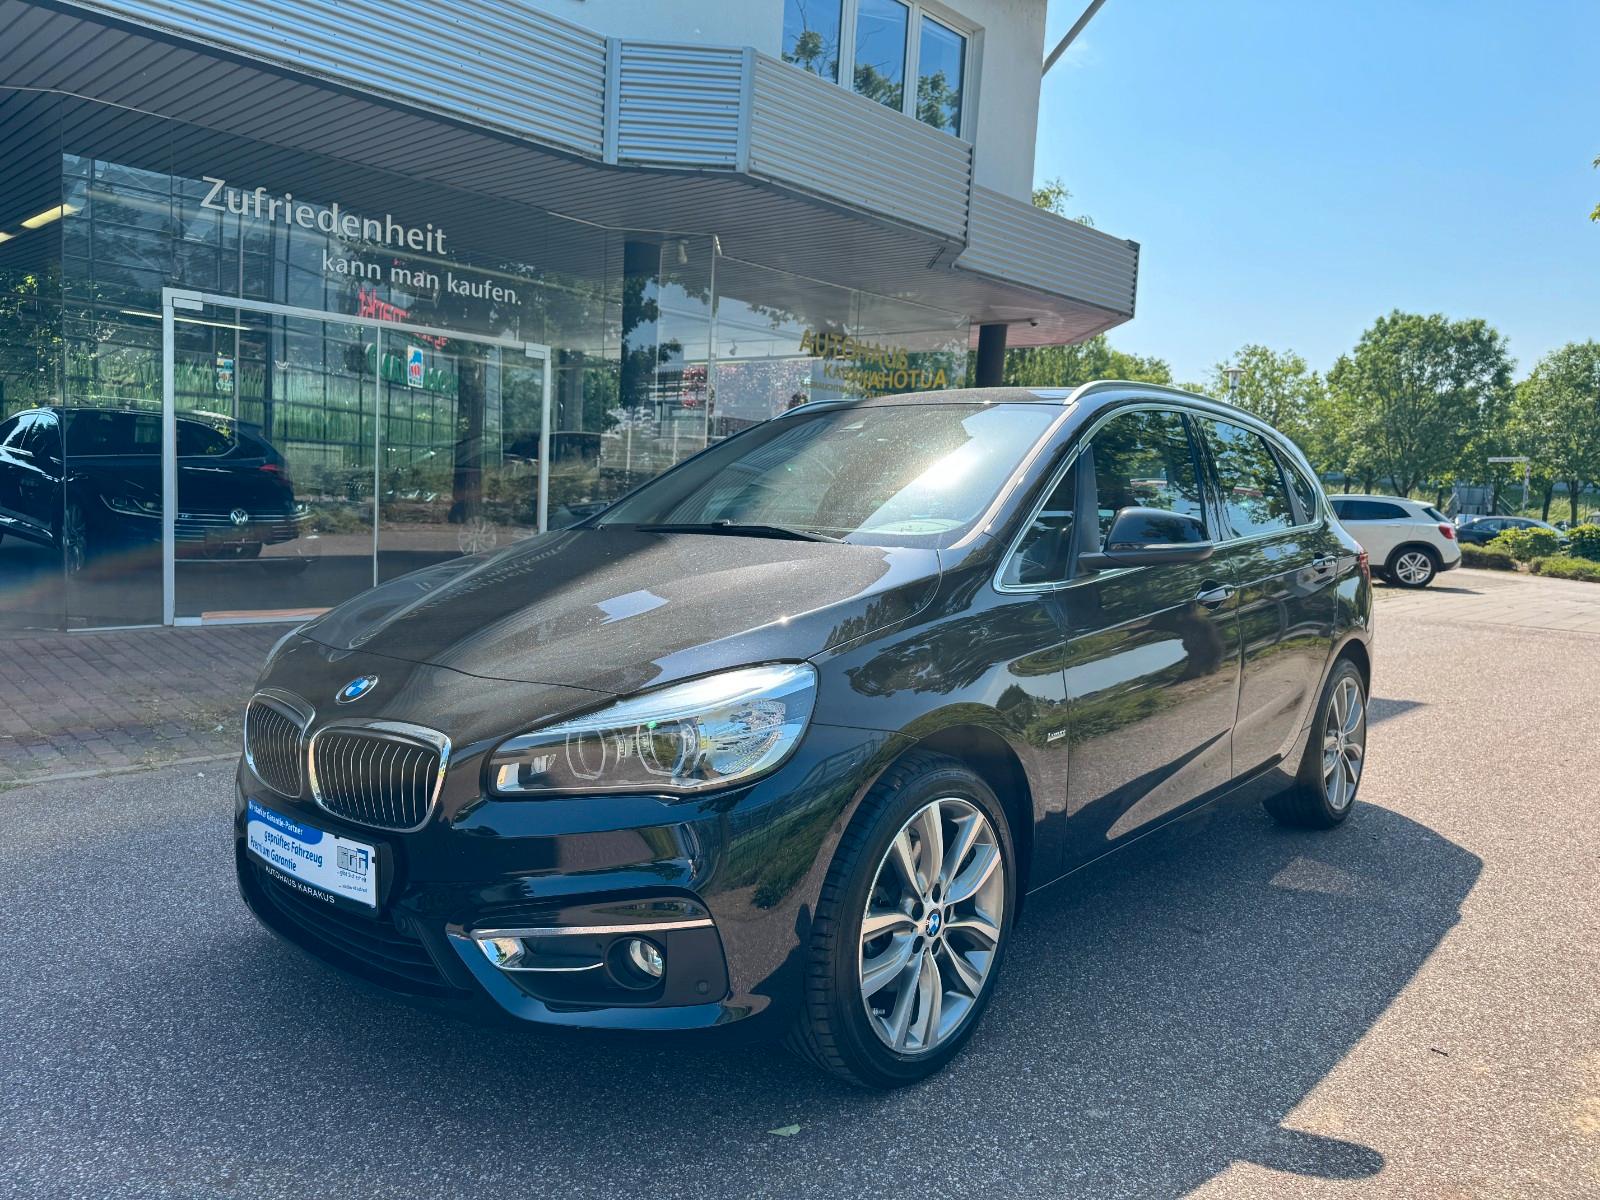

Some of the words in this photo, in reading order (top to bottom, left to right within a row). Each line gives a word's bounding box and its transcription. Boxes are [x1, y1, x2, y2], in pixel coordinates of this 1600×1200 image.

[200, 175, 448, 255] Zufriedenheit
[322, 249, 382, 280] kann
[391, 266, 440, 290] man
[447, 272, 522, 305] kaufen.
[799, 328, 909, 370] AUTOHAUS
[264, 831, 291, 852] geprüftes
[291, 841, 323, 867] Fahrzeug
[271, 849, 297, 872] Garantie
[265, 865, 297, 888] AUTOHAUS
[298, 883, 335, 904] KARAKUS
